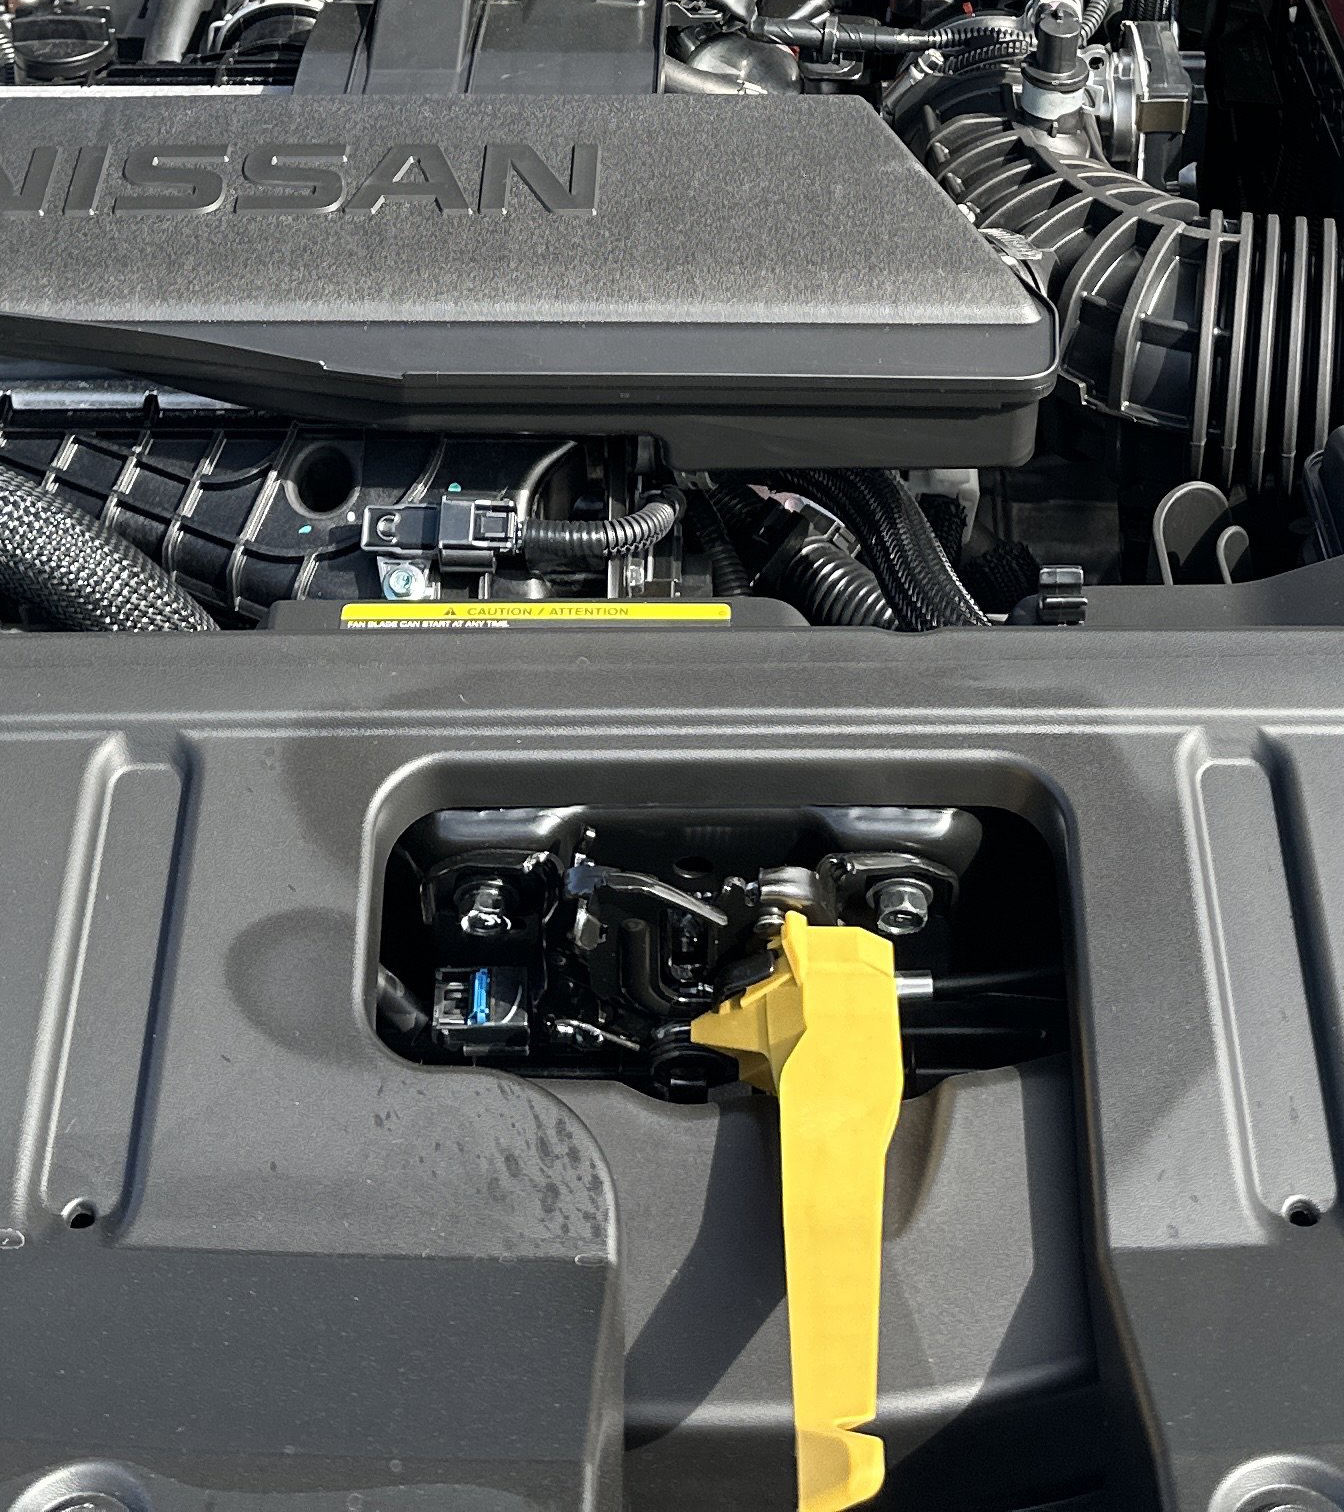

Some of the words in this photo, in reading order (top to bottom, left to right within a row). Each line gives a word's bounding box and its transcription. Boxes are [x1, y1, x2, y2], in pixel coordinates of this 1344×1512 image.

[466, 607, 532, 616] CAUTION
[549, 607, 630, 616] ATTENTION
[347, 620, 366, 628] FAN
[399, 620, 421, 628] CAN
[422, 620, 452, 628] START
[452, 620, 464, 628] AT
[464, 620, 487, 628] ANY
